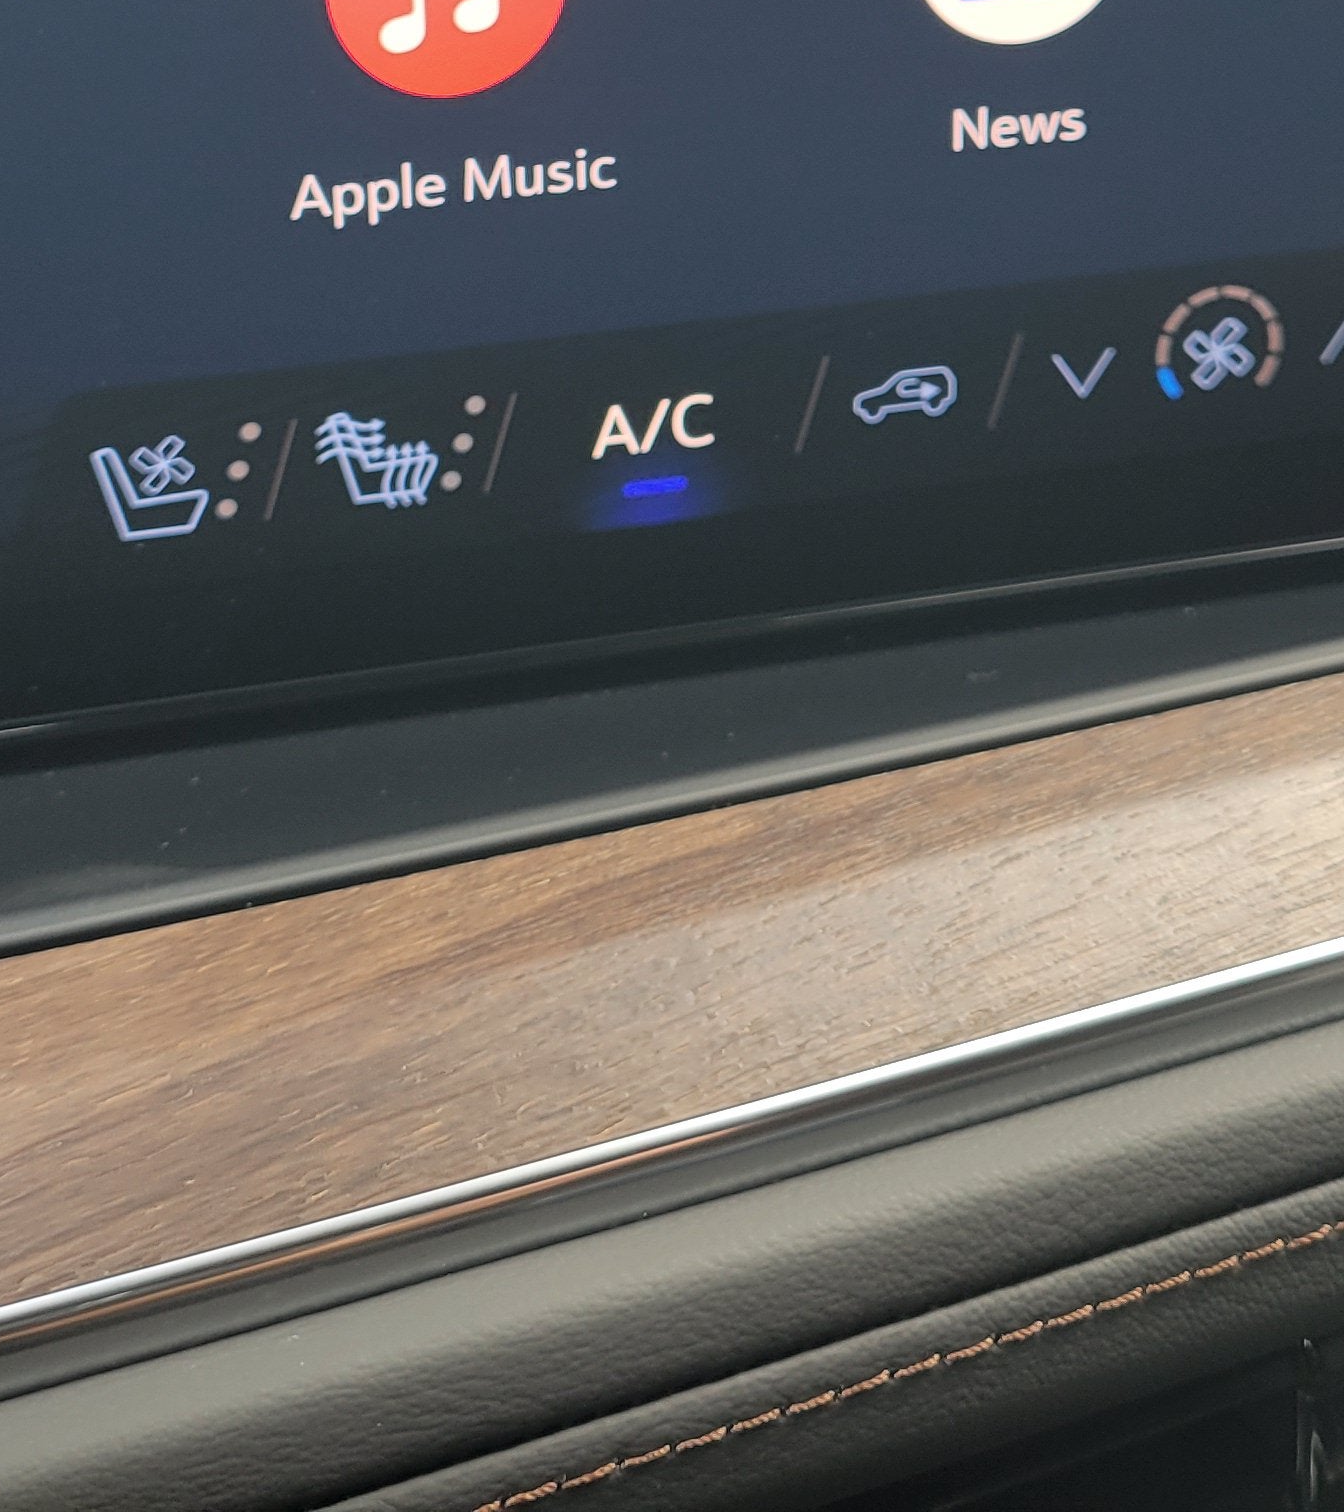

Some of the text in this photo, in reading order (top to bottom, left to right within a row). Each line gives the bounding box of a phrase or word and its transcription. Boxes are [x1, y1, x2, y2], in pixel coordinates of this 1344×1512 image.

[951, 105, 1088, 153] News
[289, 148, 618, 230] Apple Music
[591, 393, 716, 460] A/C
